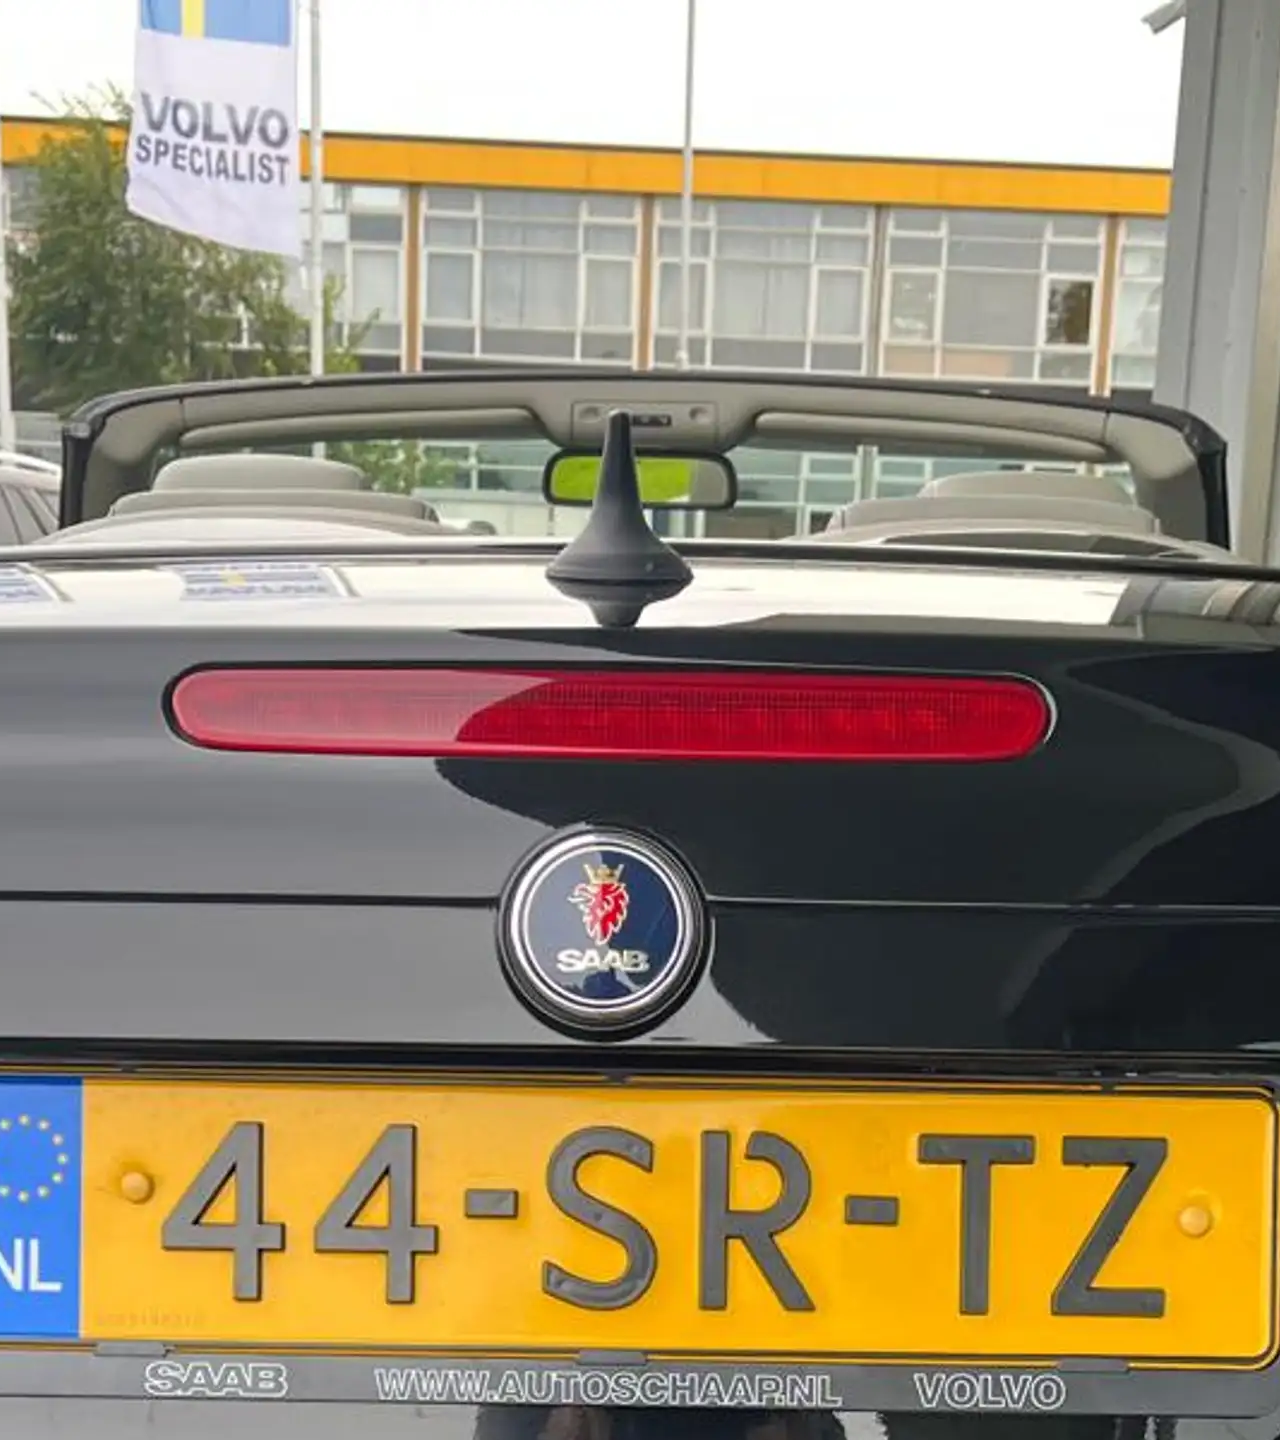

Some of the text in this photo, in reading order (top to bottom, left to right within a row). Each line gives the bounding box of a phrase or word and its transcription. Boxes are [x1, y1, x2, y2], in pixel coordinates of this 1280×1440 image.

[140, 92, 289, 149] VOLVO
[135, 133, 289, 186] SPECIALIST
[556, 948, 651, 973] SAAB
[160, 1119, 1170, 1319] 44-SR-TZ
[144, 1361, 1066, 1408] SAAB WWW.AUTOSCHAAP.NL VOLVO
